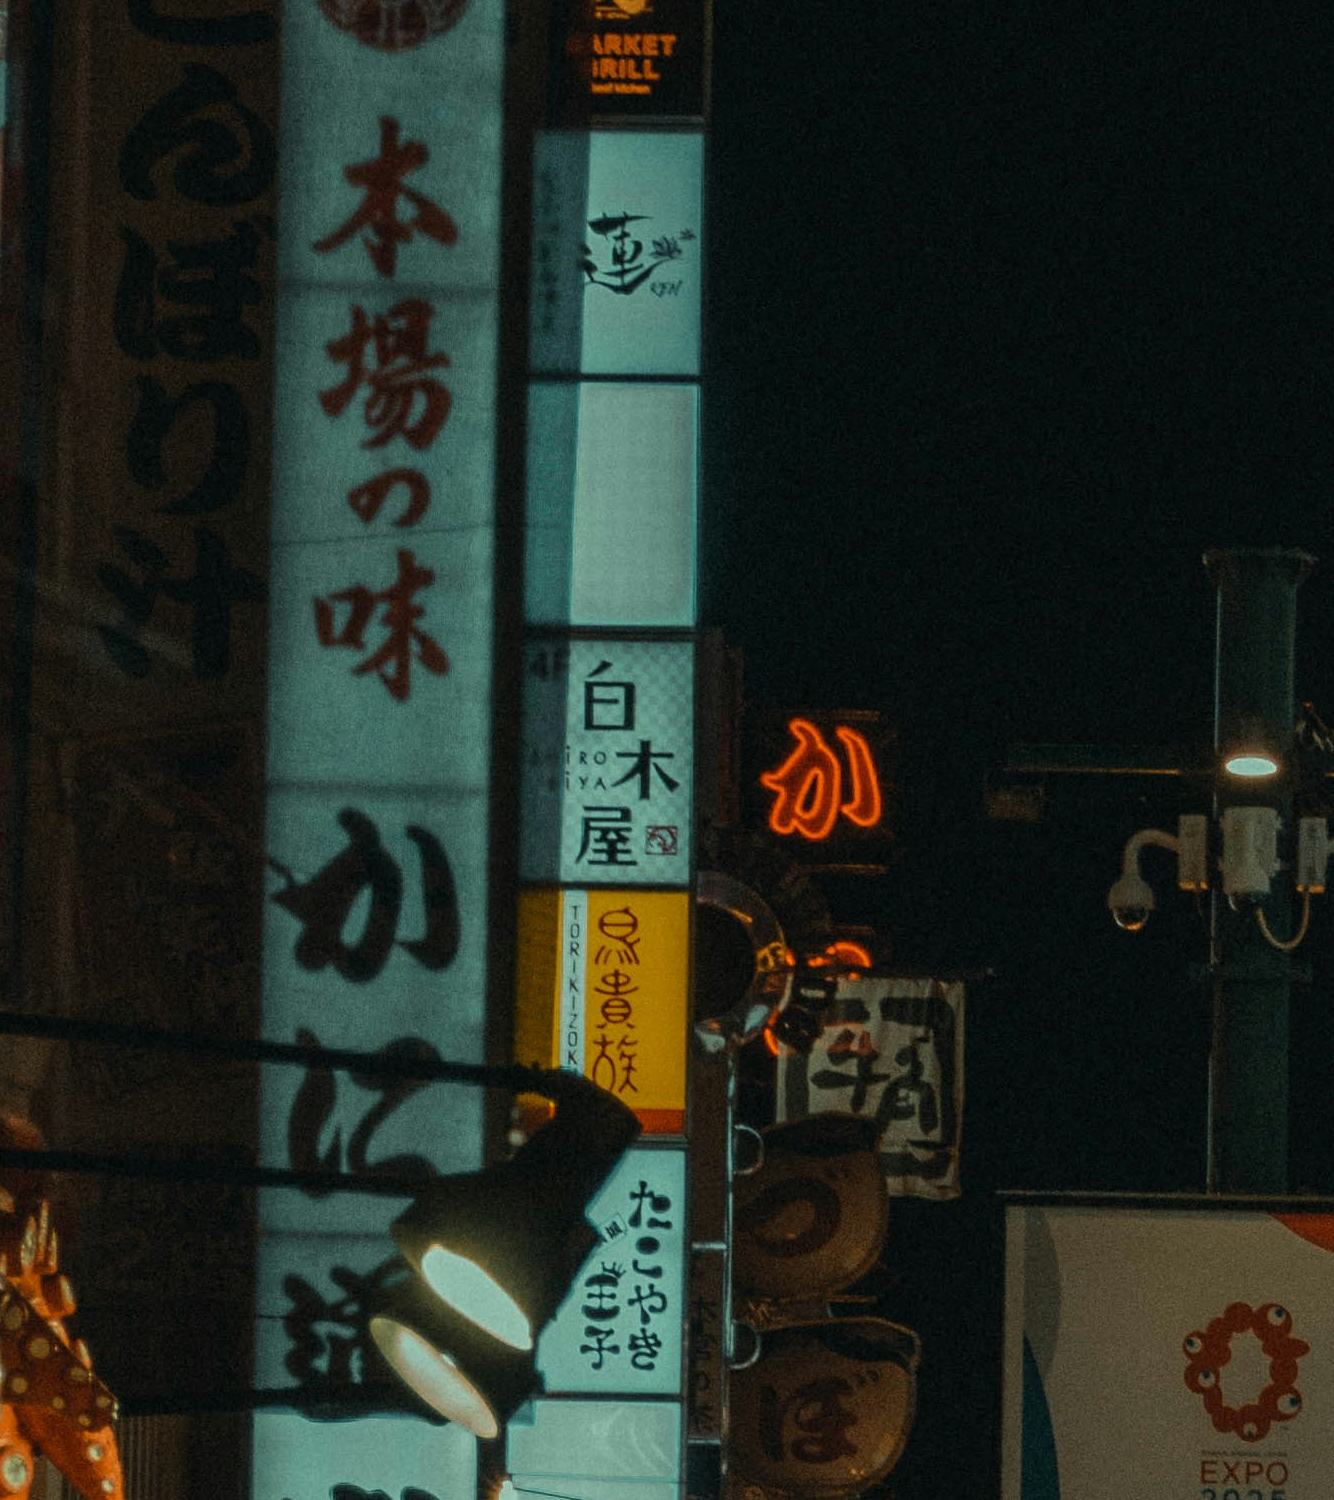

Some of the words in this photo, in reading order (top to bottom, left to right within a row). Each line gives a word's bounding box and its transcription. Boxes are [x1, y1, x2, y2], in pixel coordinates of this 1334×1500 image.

[589, 32, 678, 57] ARKET
[589, 58, 661, 81] RILL
[313, 116, 458, 699] 本場の味
[574, 660, 680, 867] 白木屋
[761, 717, 882, 841] か
[566, 904, 581, 1067] TORIKIZOK
[627, 1180, 673, 1371] たこやき
[1200, 1460, 1289, 1486] EXPO
